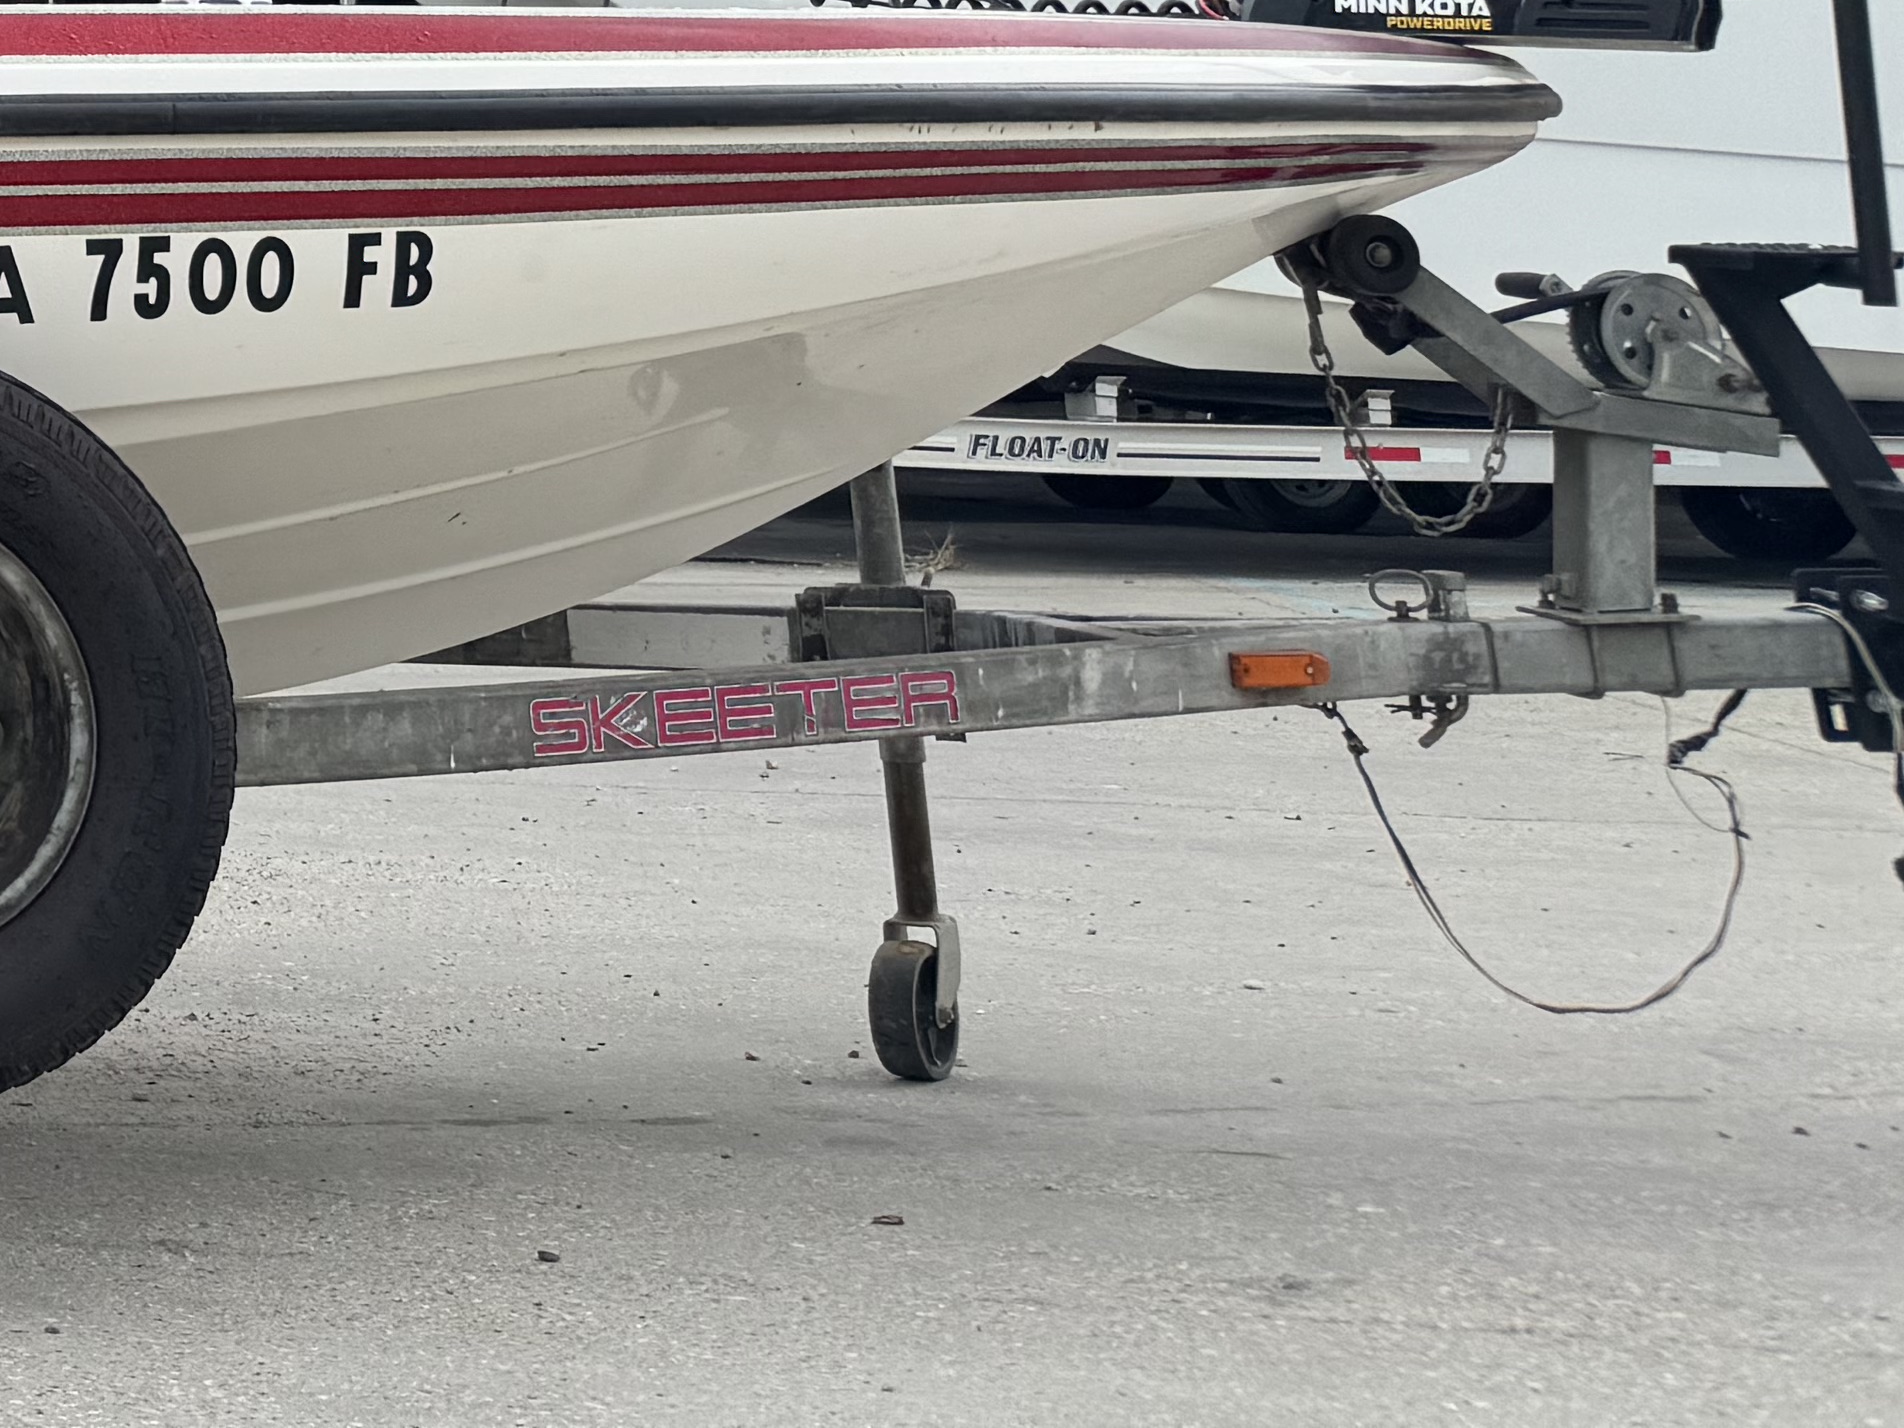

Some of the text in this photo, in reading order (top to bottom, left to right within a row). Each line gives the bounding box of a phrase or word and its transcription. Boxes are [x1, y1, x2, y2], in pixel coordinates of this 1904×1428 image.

[1386, 16, 1493, 31] POWERDRIVE
[86, 236, 295, 322] 7500
[343, 230, 434, 309] FB
[967, 433, 1110, 463] FLOAT-ON
[529, 669, 960, 758] SKEETER
